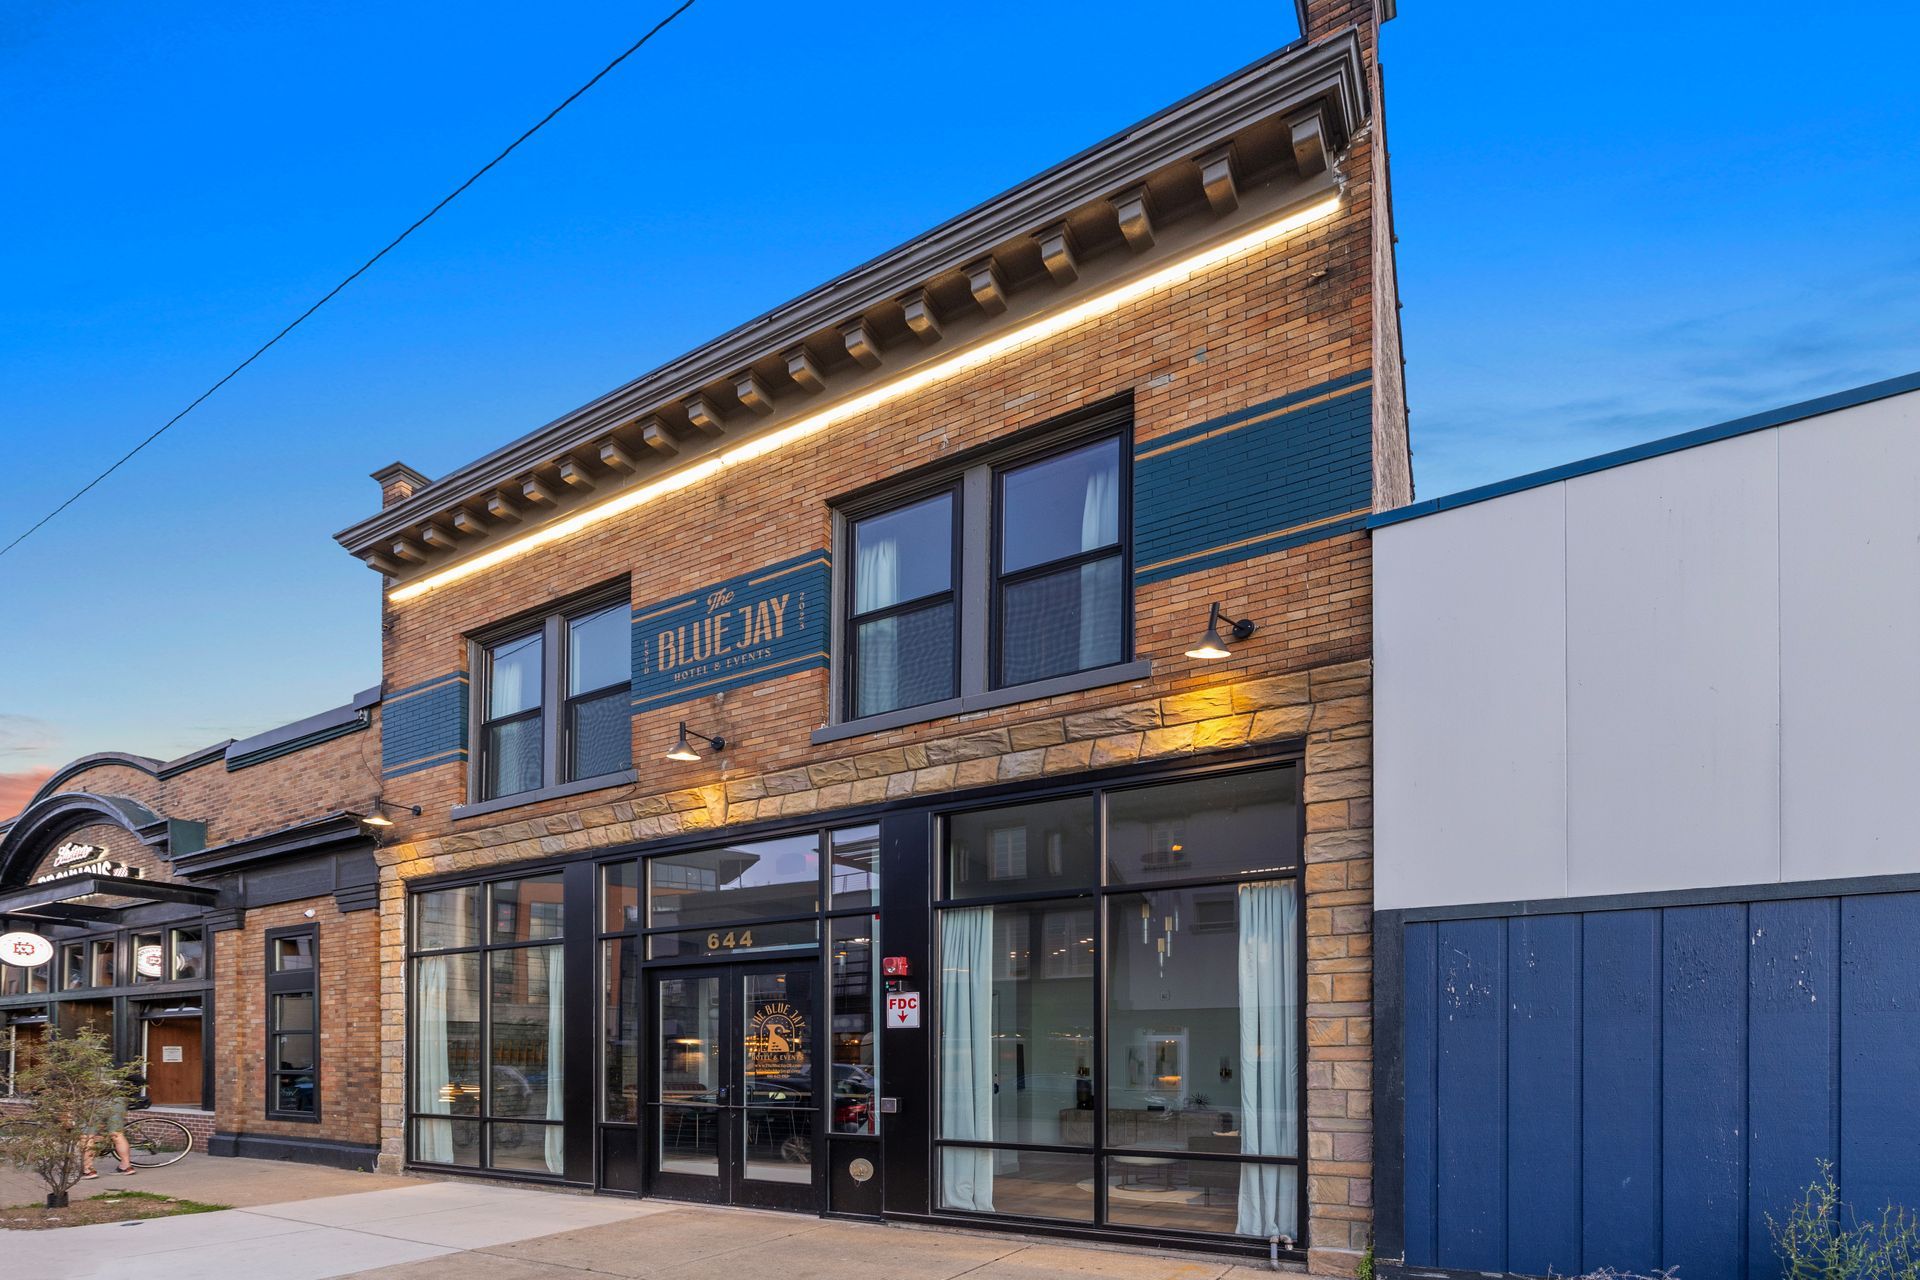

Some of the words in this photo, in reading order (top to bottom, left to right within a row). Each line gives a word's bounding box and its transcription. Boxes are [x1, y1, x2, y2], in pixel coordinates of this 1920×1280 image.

[708, 588, 735, 613] The
[658, 612, 731, 671] BLUE
[736, 594, 789, 648] JAY
[674, 666, 708, 682] HOTEL
[714, 661, 721, 672] &
[726, 648, 771, 667] EVENTS
[707, 930, 753, 949] 644
[751, 1010, 766, 1028] THE
[765, 1003, 791, 1015] BLUE
[790, 1009, 806, 1027] JAY
[889, 998, 917, 1009] FDC
